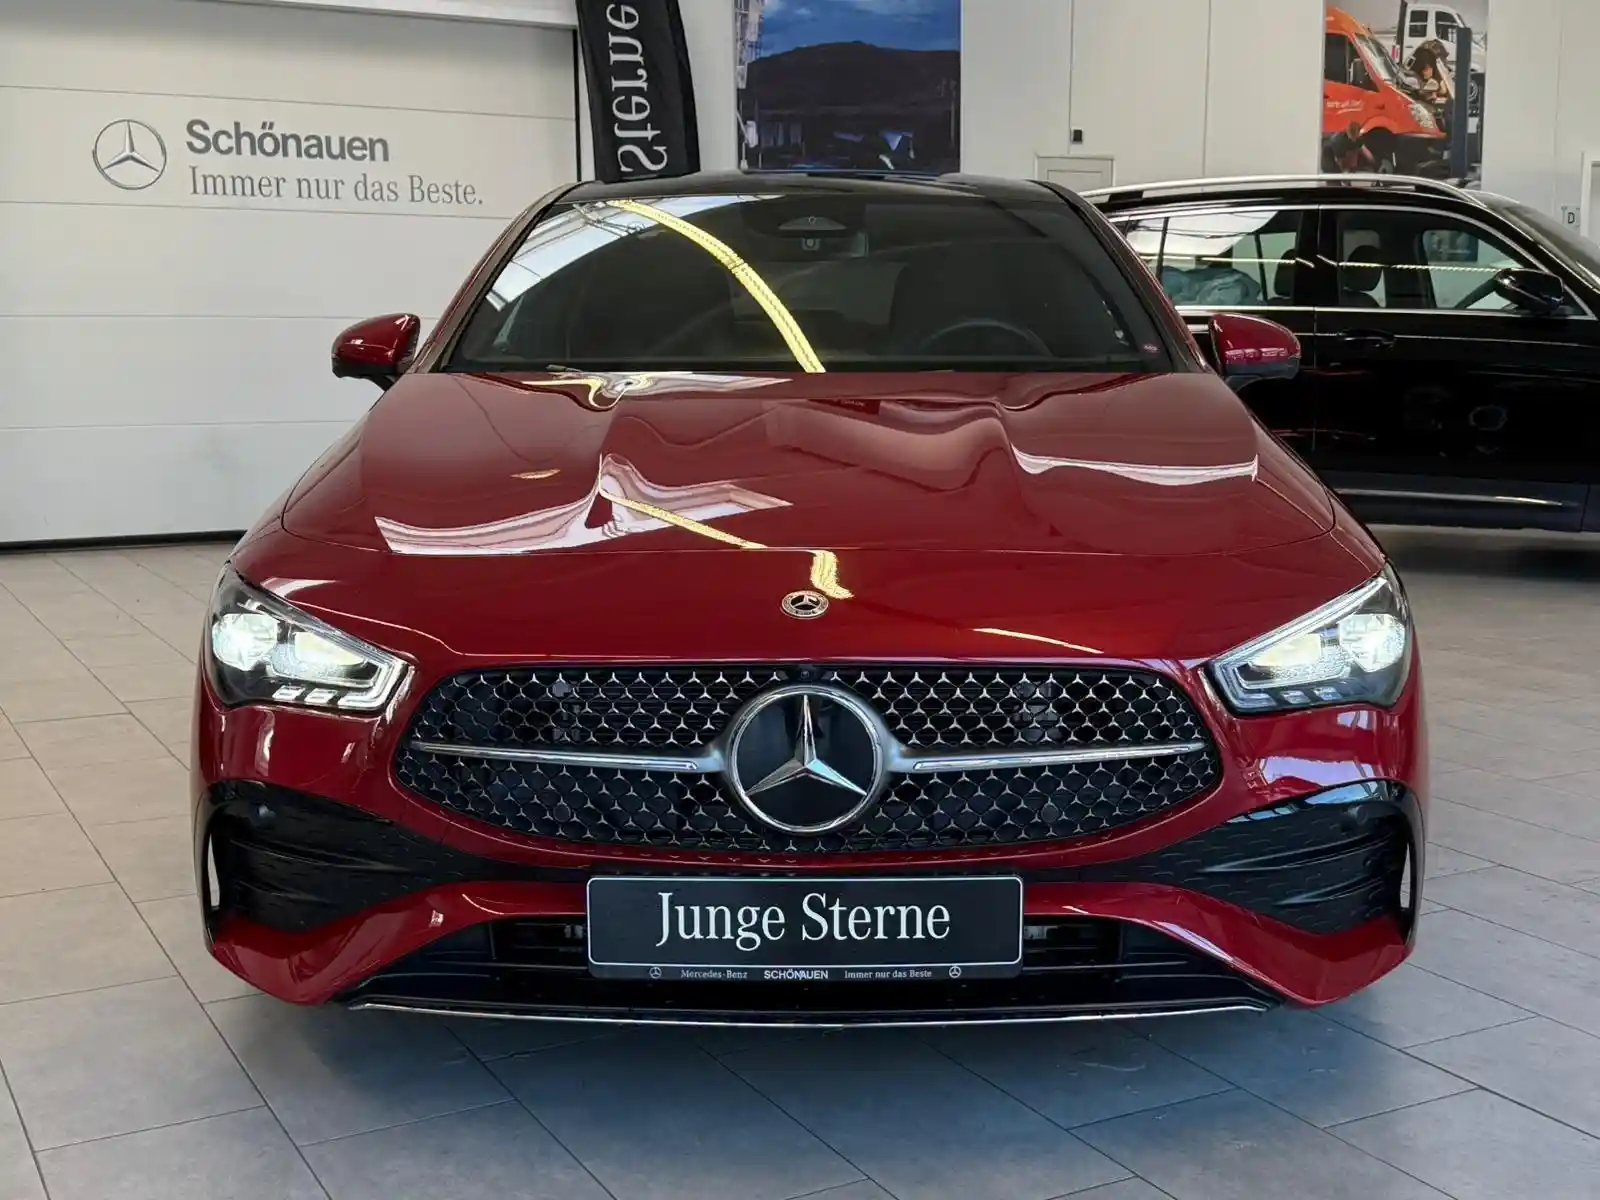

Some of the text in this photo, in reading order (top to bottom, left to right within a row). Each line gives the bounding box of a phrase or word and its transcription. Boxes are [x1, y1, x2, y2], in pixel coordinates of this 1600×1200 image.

[186, 118, 390, 162] Schönauen
[188, 165, 484, 205] Immer nur das Beste.
[655, 892, 951, 952] Junge Sterne
[680, 968, 932, 980] Mercedes-Benz SCHÖNAUEN Immer nur das Beste
